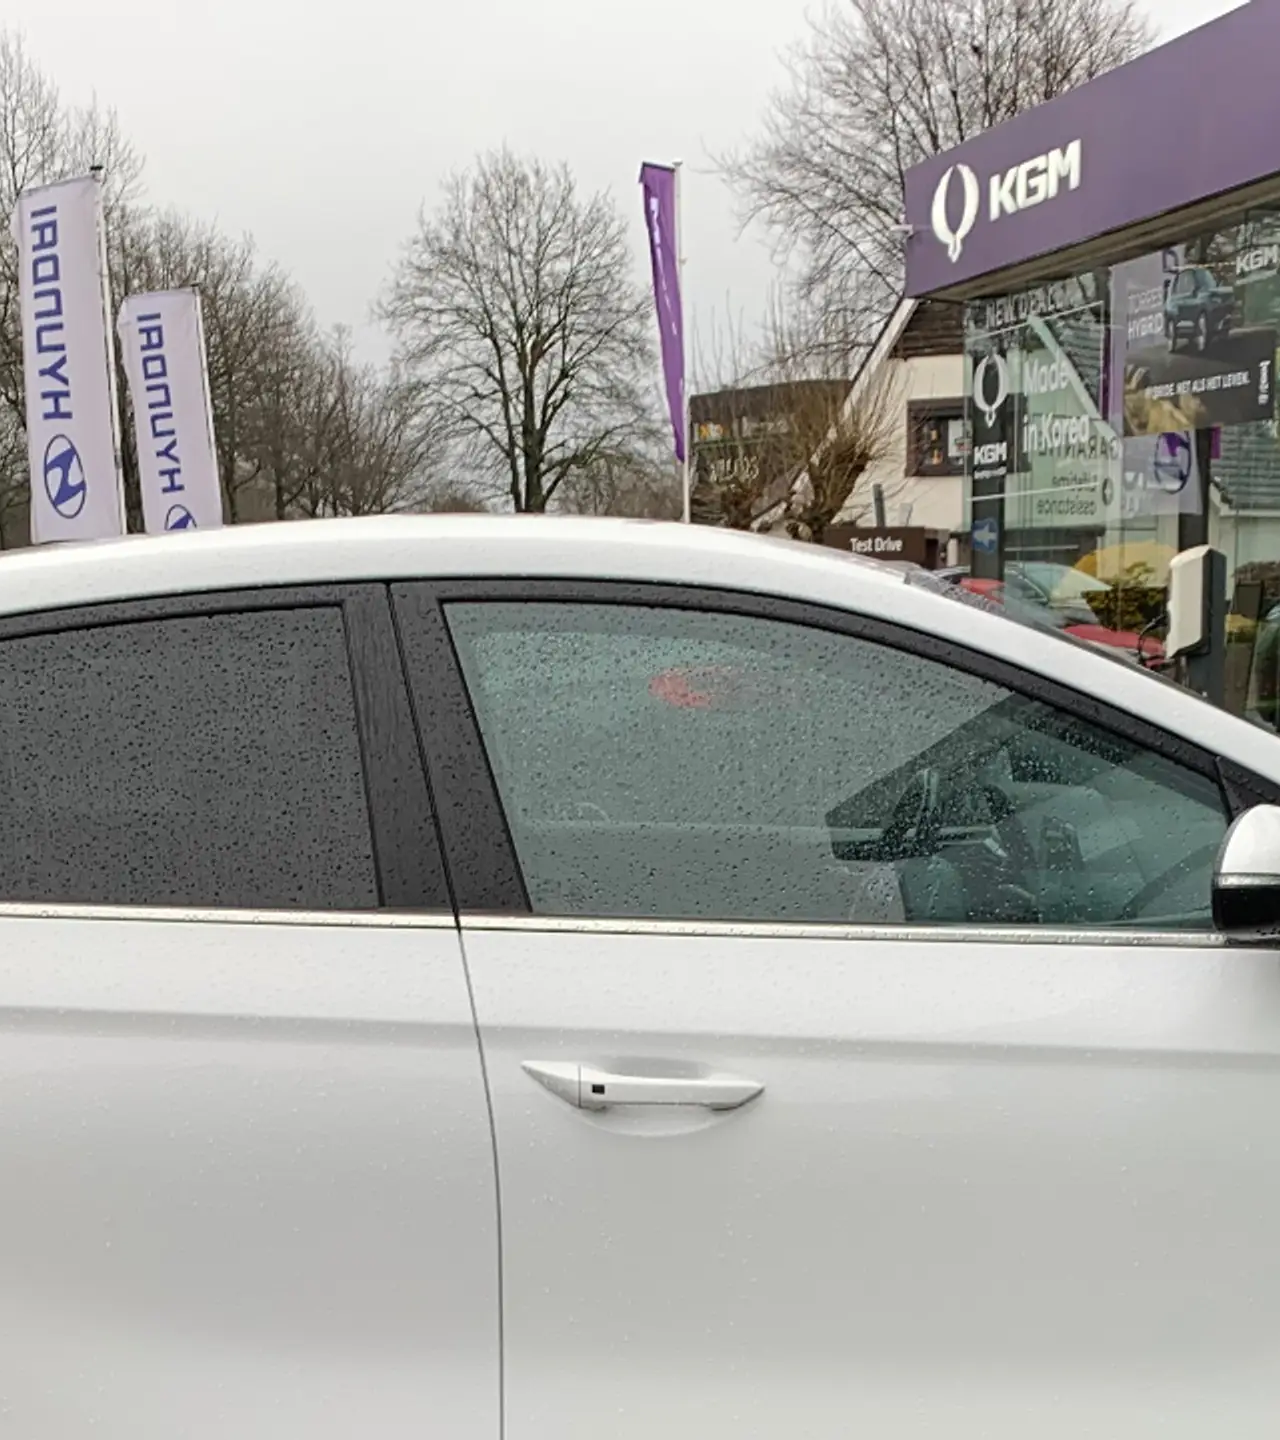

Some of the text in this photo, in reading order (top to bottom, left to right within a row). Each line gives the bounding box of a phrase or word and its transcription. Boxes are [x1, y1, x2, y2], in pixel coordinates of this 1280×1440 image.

[988, 139, 1082, 221] KGM
[1235, 244, 1279, 275] KGM
[1024, 358, 1070, 396] Made
[1023, 411, 1090, 453] in Korea
[974, 441, 1007, 465] KGM
[850, 536, 902, 552] Test Drive
